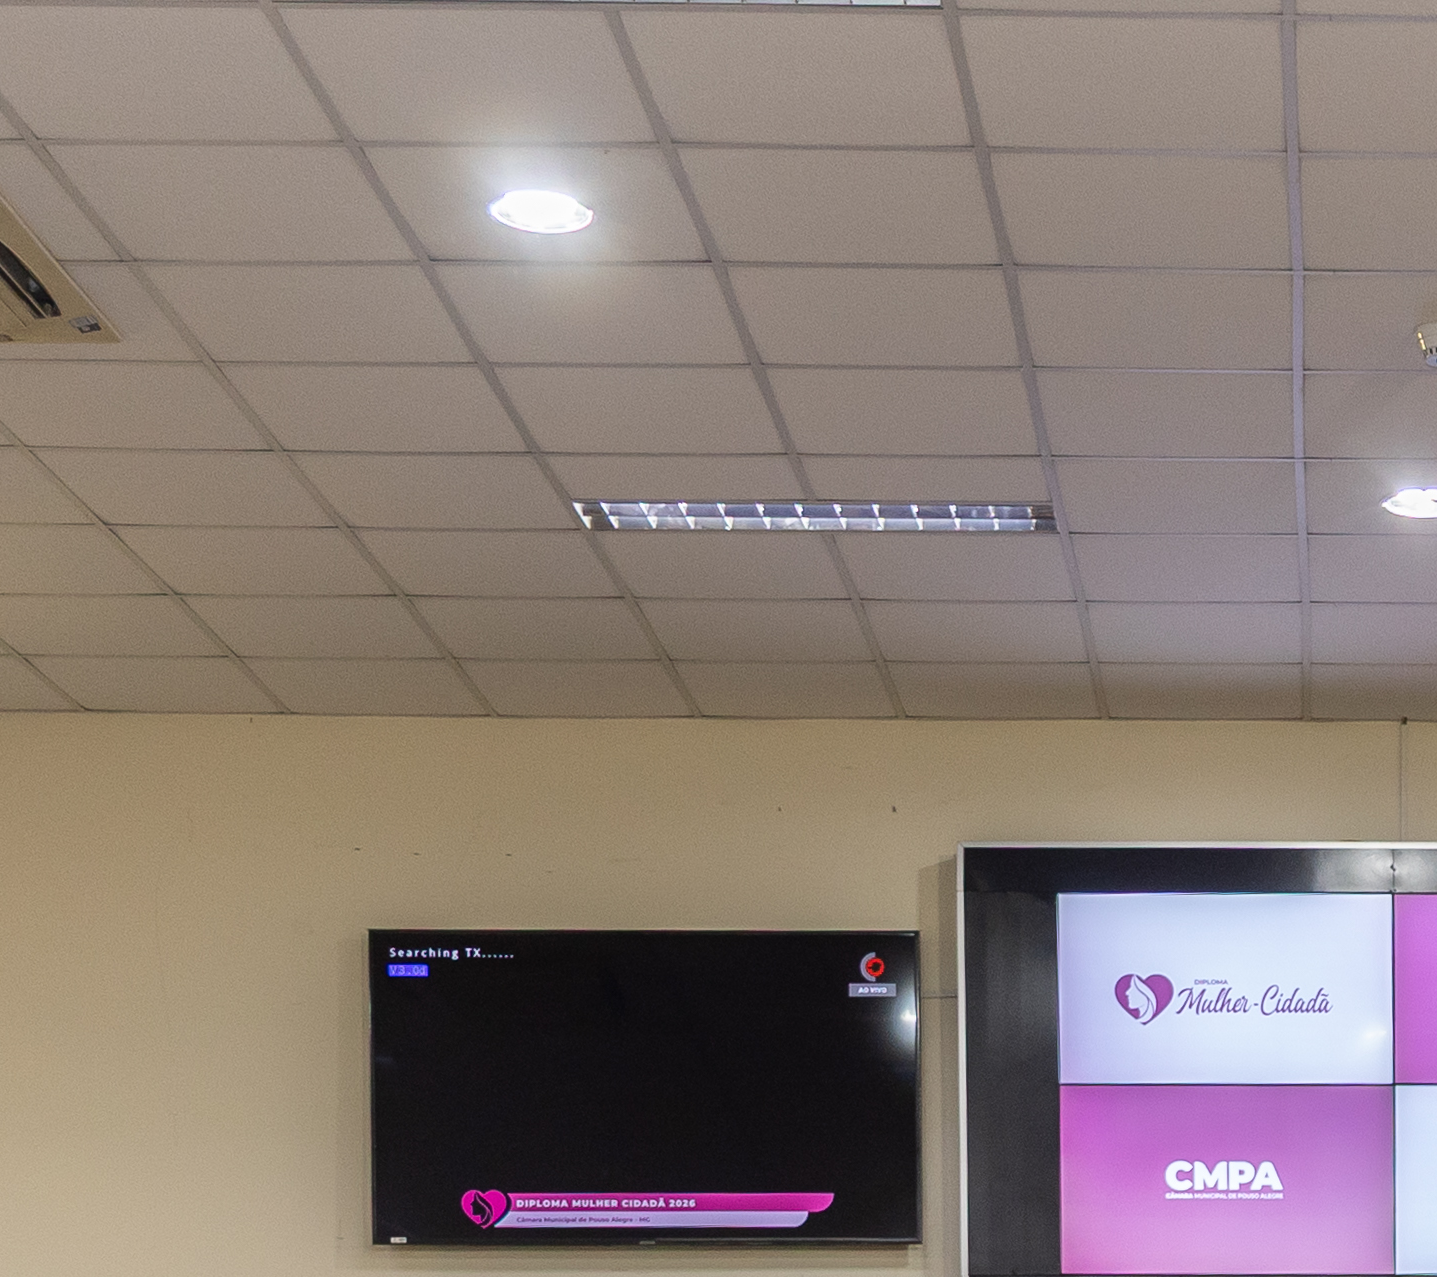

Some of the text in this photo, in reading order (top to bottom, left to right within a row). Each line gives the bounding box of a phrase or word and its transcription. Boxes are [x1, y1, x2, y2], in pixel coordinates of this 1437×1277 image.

[389, 947, 459, 960] Searching
[1194, 978, 1228, 986] DIPLOMA
[1165, 1159, 1284, 1191] CMPA
[516, 1197, 697, 1208] DIPLOMA MULHER CIDADÃ 2026
[544, 1216, 577, 1224] Municipal
